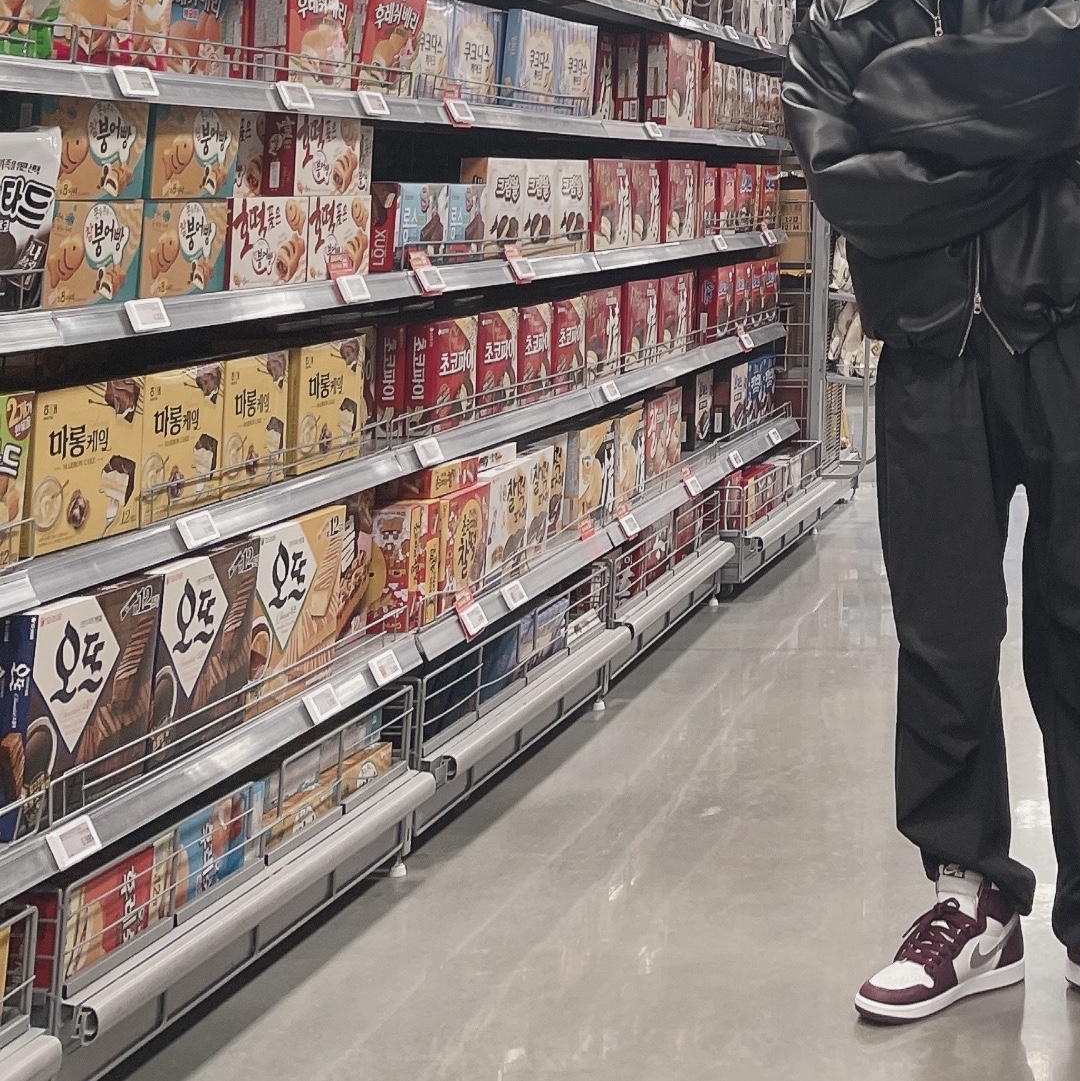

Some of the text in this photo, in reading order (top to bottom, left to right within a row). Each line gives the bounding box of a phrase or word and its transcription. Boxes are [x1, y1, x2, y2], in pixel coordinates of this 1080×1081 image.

[374, 2, 420, 34] 후레쉬베리
[411, 336, 427, 401] 초코파이
[439, 343, 475, 377] 초코파이
[484, 341, 516, 365] 초코파이
[153, 404, 202, 439] 마롱케익
[48, 424, 112, 462] 마롱케익
